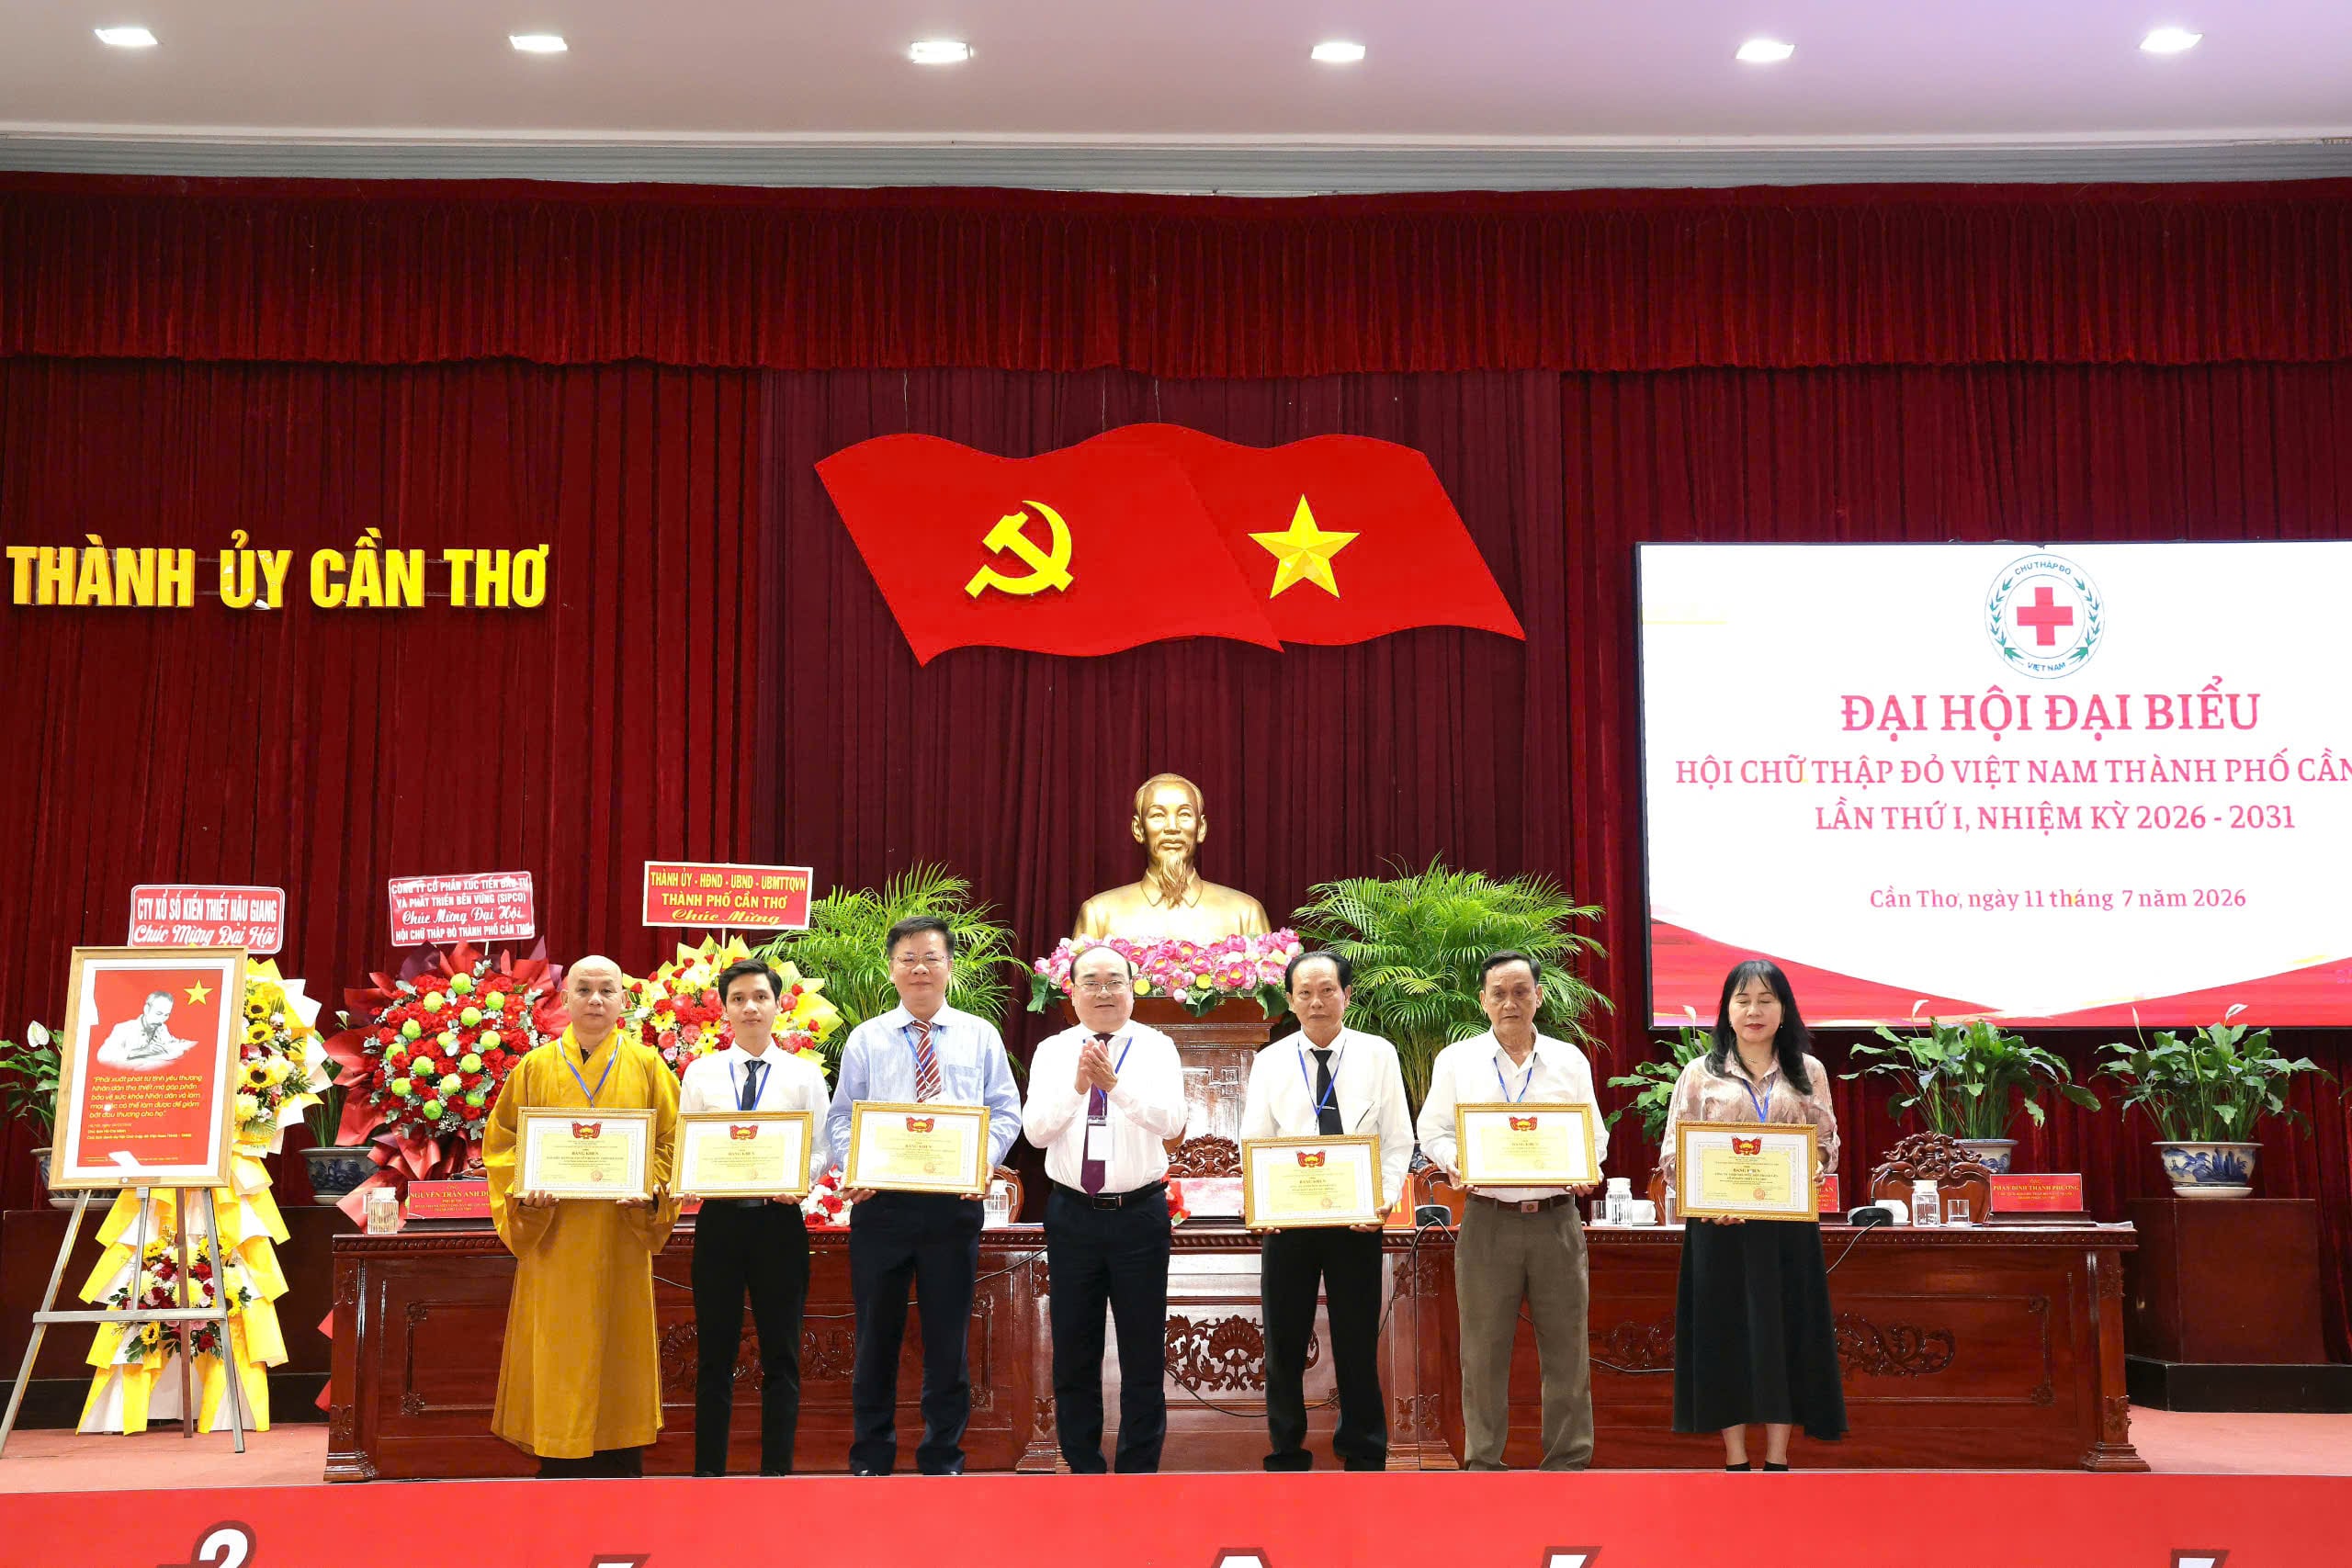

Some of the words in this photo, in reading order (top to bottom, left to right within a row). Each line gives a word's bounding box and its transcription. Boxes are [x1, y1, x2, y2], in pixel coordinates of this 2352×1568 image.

[6, 534, 196, 607] THÀNH
[220, 529, 293, 608] ỦY
[311, 527, 425, 608] CẦN
[444, 544, 549, 607] THƠ
[1840, 694, 1928, 742] ĐẠI
[1940, 684, 2032, 742] HỘI
[2044, 694, 2132, 741] ĐẠI
[2143, 676, 2261, 730] BIỂU
[1676, 754, 1733, 790] HỘI
[1741, 753, 1806, 783] CHỮ
[1811, 754, 1893, 790] THẬP
[1900, 754, 1944, 783] ĐỎ
[1951, 754, 2019, 789] VIỆT
[2028, 760, 2098, 783] NAM
[2105, 753, 2217, 783] THÀNH
[2224, 748, 2290, 782] PHỐ
[1815, 795, 1873, 829] LẦN
[1882, 801, 1947, 829] THỨ
[1953, 807, 1970, 832] I,
[1977, 800, 2082, 836] NHIỆM
[2090, 800, 2130, 829] KỲ
[2137, 806, 2206, 829] 2026
[2229, 806, 2295, 829] 2031
[650, 867, 678, 886] THÀNH
[682, 867, 693, 886] ỦY
[700, 874, 723, 887] HĐND
[731, 874, 753, 889] UBND
[762, 875, 807, 893] UBMTTQVN
[138, 897, 153, 920] CTY
[155, 889, 168, 920] XỔ
[169, 891, 182, 920] SỐ
[183, 891, 203, 920] KIẾN
[206, 892, 229, 921] THIẾT
[231, 894, 248, 926] HẬU
[250, 899, 277, 922] GIANG
[662, 891, 702, 906] THÀNH
[707, 891, 731, 908] PHỐ
[735, 890, 759, 908] CẦN
[763, 896, 787, 909] THƠ
[1870, 886, 1911, 908] Cần
[1917, 889, 1962, 909] Thơ,
[1969, 888, 2019, 911] ngày
[2025, 890, 2045, 907] 11
[2049, 888, 2113, 911] tháng
[2122, 889, 2133, 907] 7
[2139, 889, 2187, 907] năm
[2193, 889, 2246, 907] 2026
[402, 910, 431, 925] Chúc
[433, 908, 468, 925] Mừng
[470, 907, 494, 923] Đại
[498, 906, 522, 921] Hội
[672, 909, 718, 921] Chúc
[722, 910, 779, 926] Mừng
[133, 924, 168, 942] Chúc
[172, 924, 215, 946] Mừng
[219, 926, 246, 946] Đại
[249, 926, 277, 948] Hội
